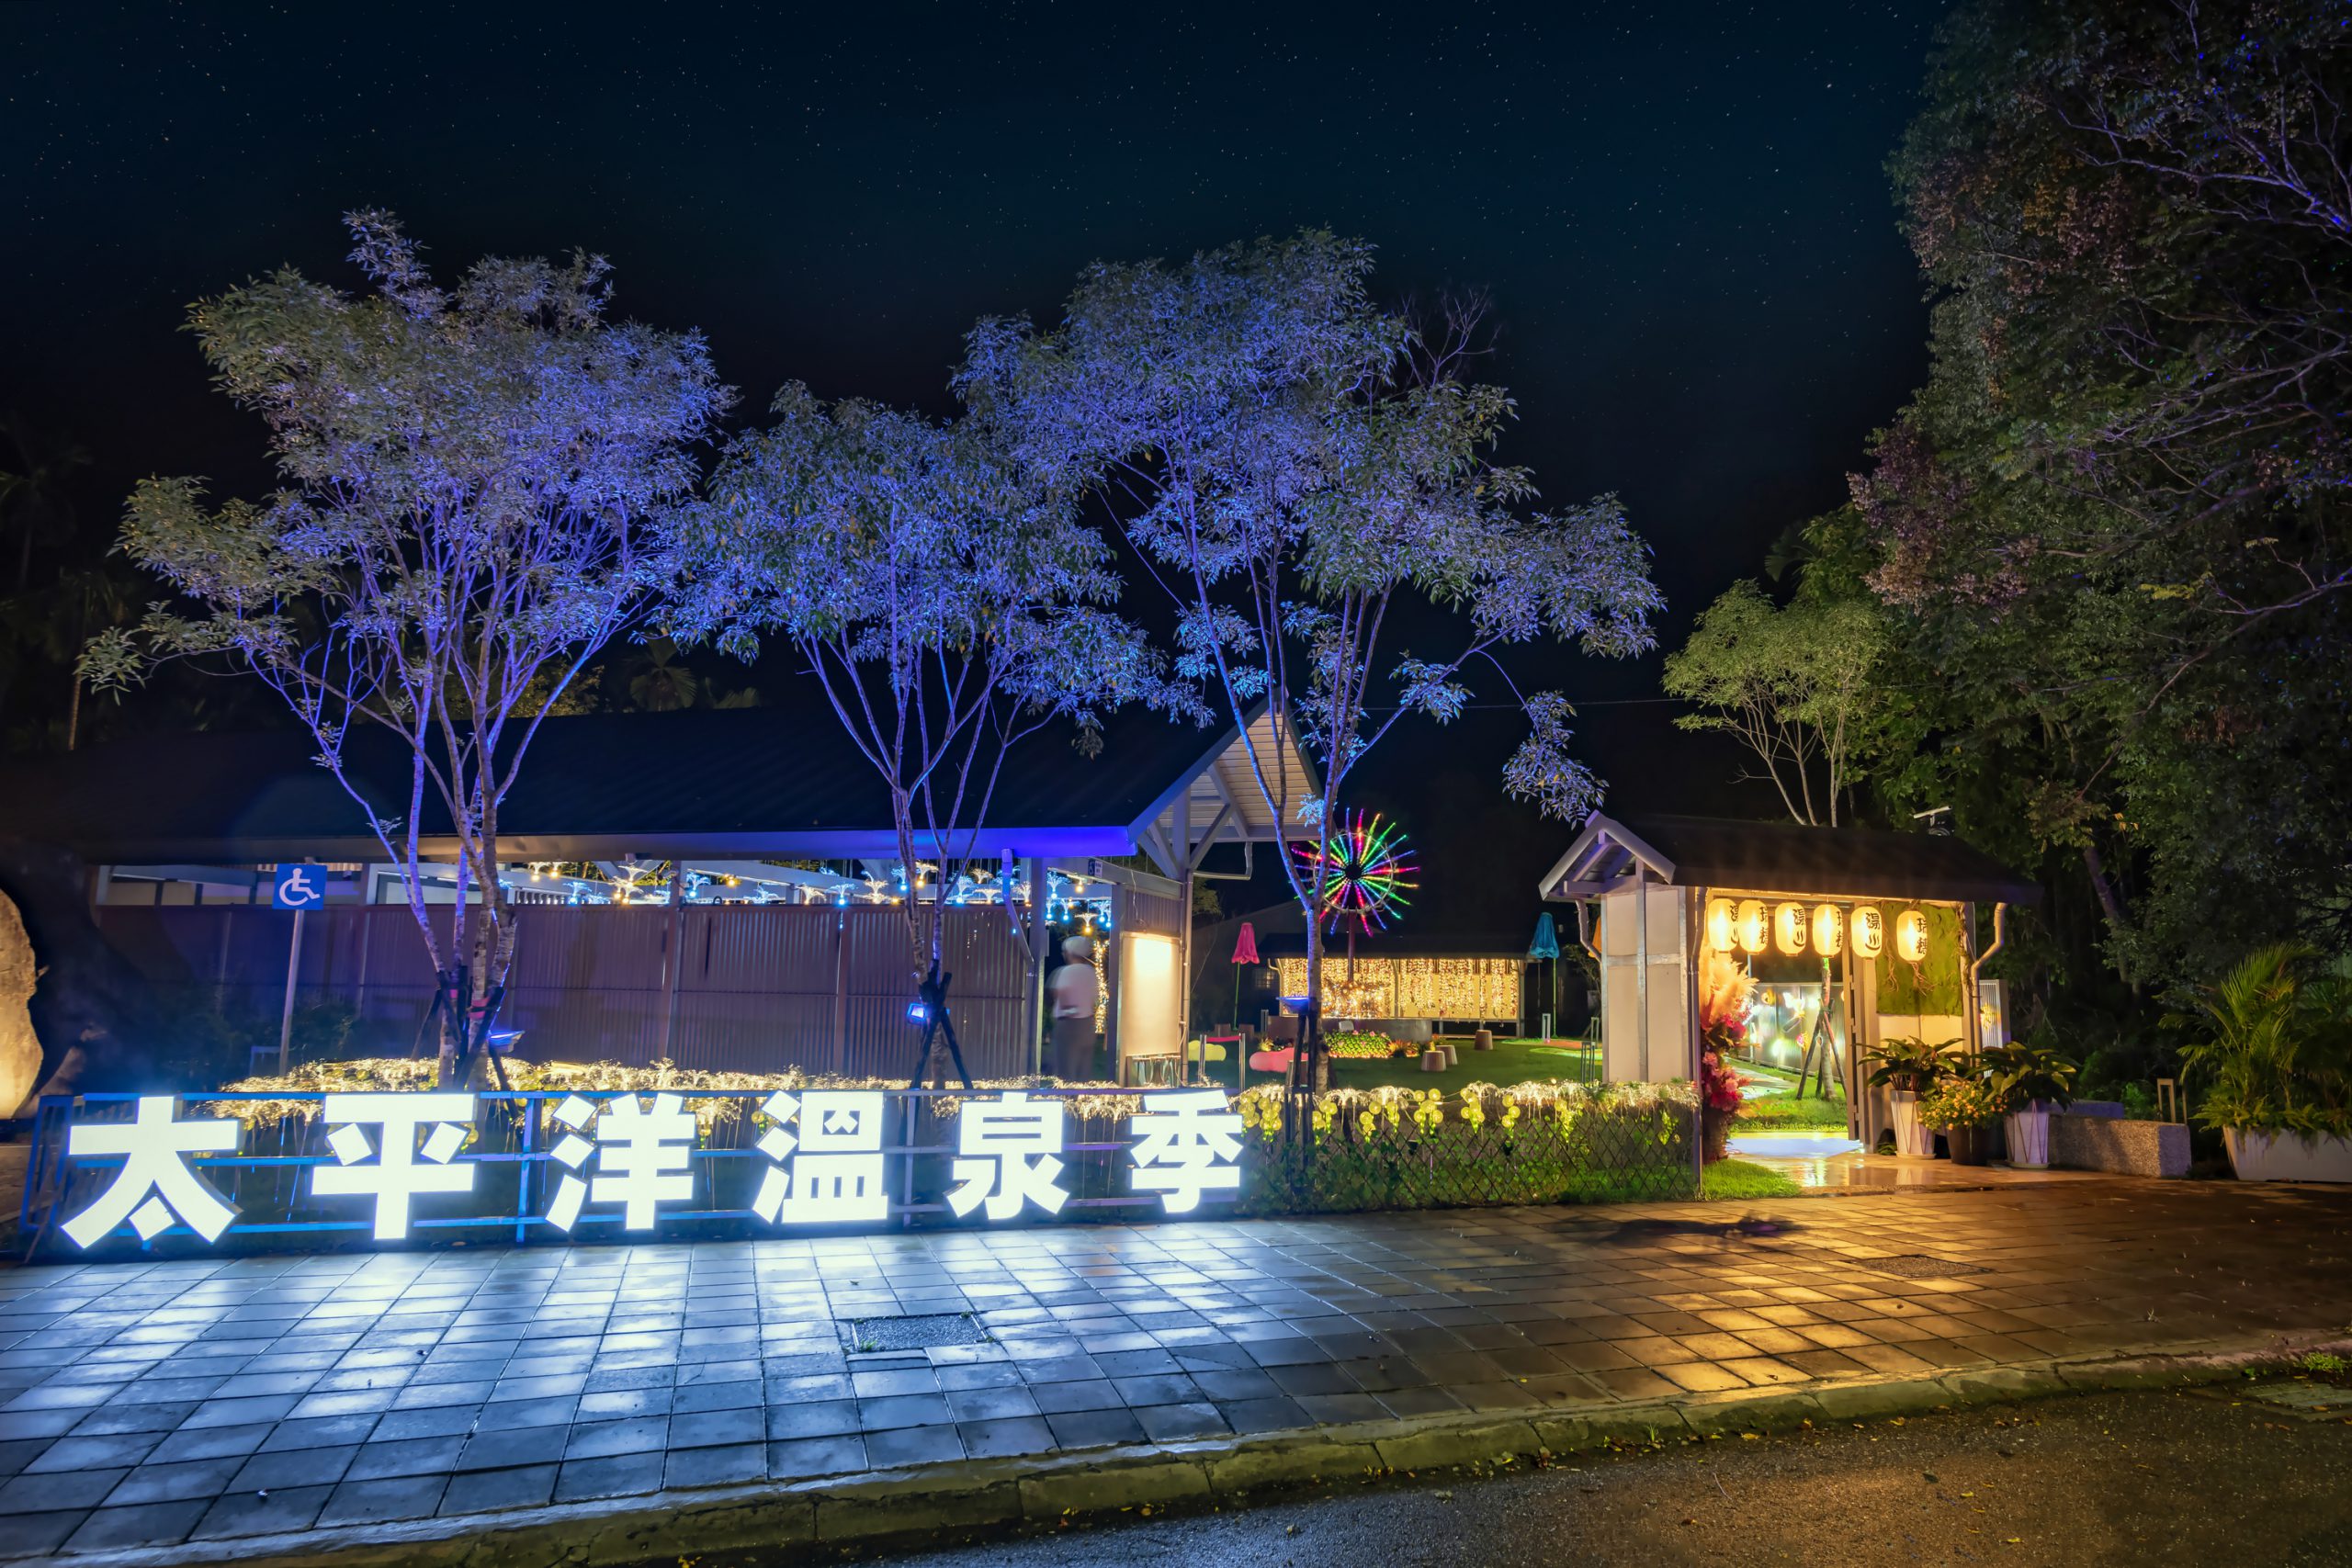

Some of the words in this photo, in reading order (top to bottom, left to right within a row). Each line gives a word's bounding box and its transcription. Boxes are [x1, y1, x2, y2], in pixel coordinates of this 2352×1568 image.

[1865, 912, 1881, 931] 湯
[61, 1089, 1245, 1248] 太平洋溫泉季
